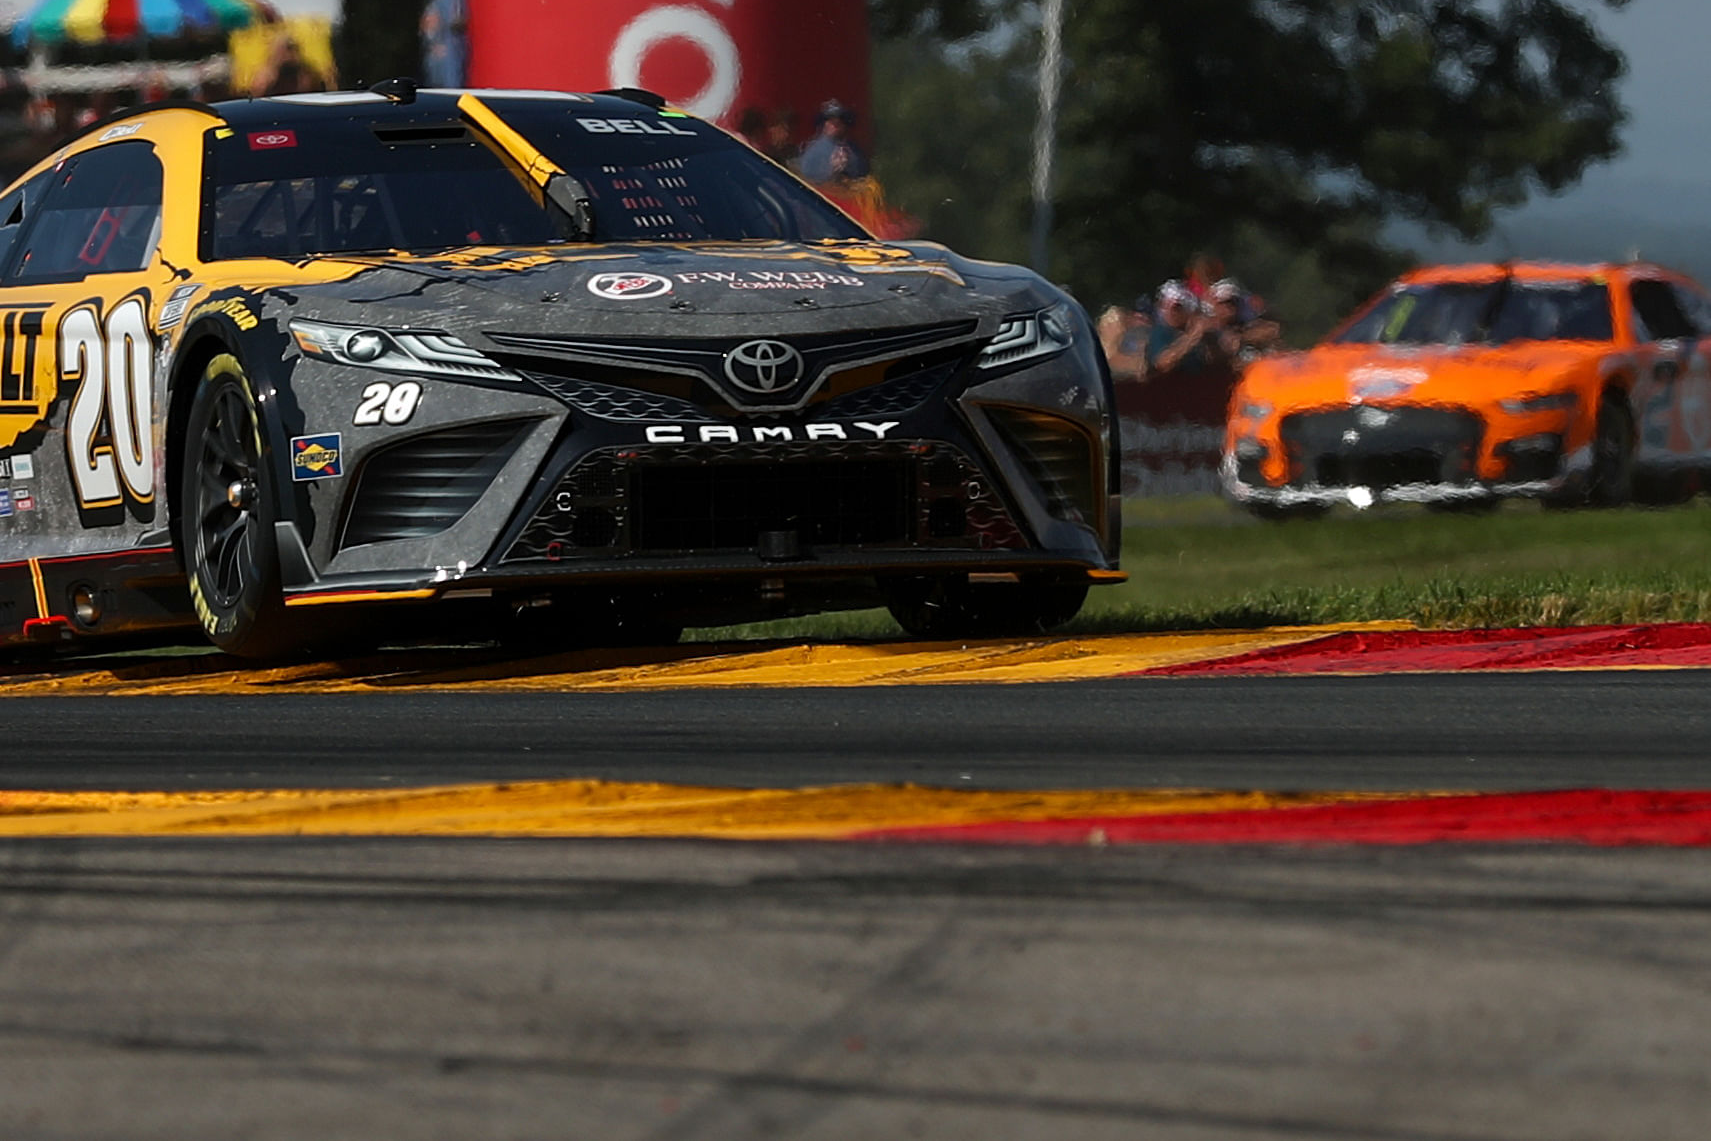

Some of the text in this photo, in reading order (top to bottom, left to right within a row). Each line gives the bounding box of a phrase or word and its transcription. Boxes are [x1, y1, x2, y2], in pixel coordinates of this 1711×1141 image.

[576, 117, 698, 136] BELL
[749, 271, 866, 288] WEBB
[59, 293, 156, 510] 20
[354, 381, 422, 425] 20
[296, 450, 337, 465] SUNOCO
